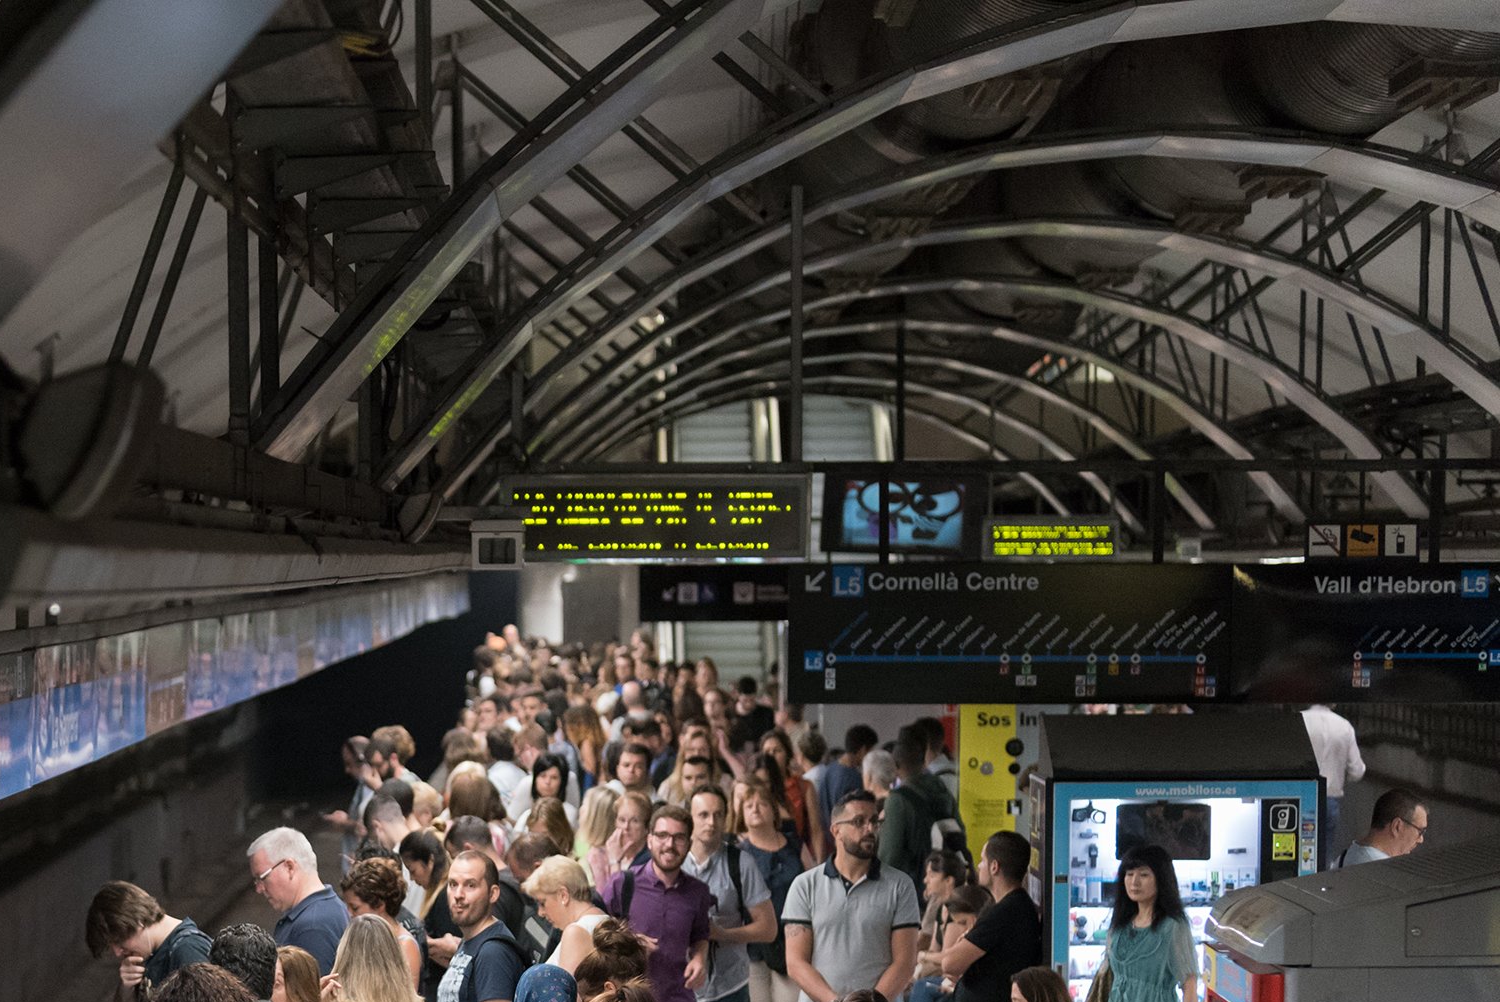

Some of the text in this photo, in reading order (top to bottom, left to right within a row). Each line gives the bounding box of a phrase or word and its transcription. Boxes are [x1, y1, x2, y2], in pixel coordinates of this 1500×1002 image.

[835, 572, 1040, 596] L5 Cornellà Centre
[1314, 576, 1487, 594] Vall d'Hebron L5
[977, 713, 1011, 727] Sos
